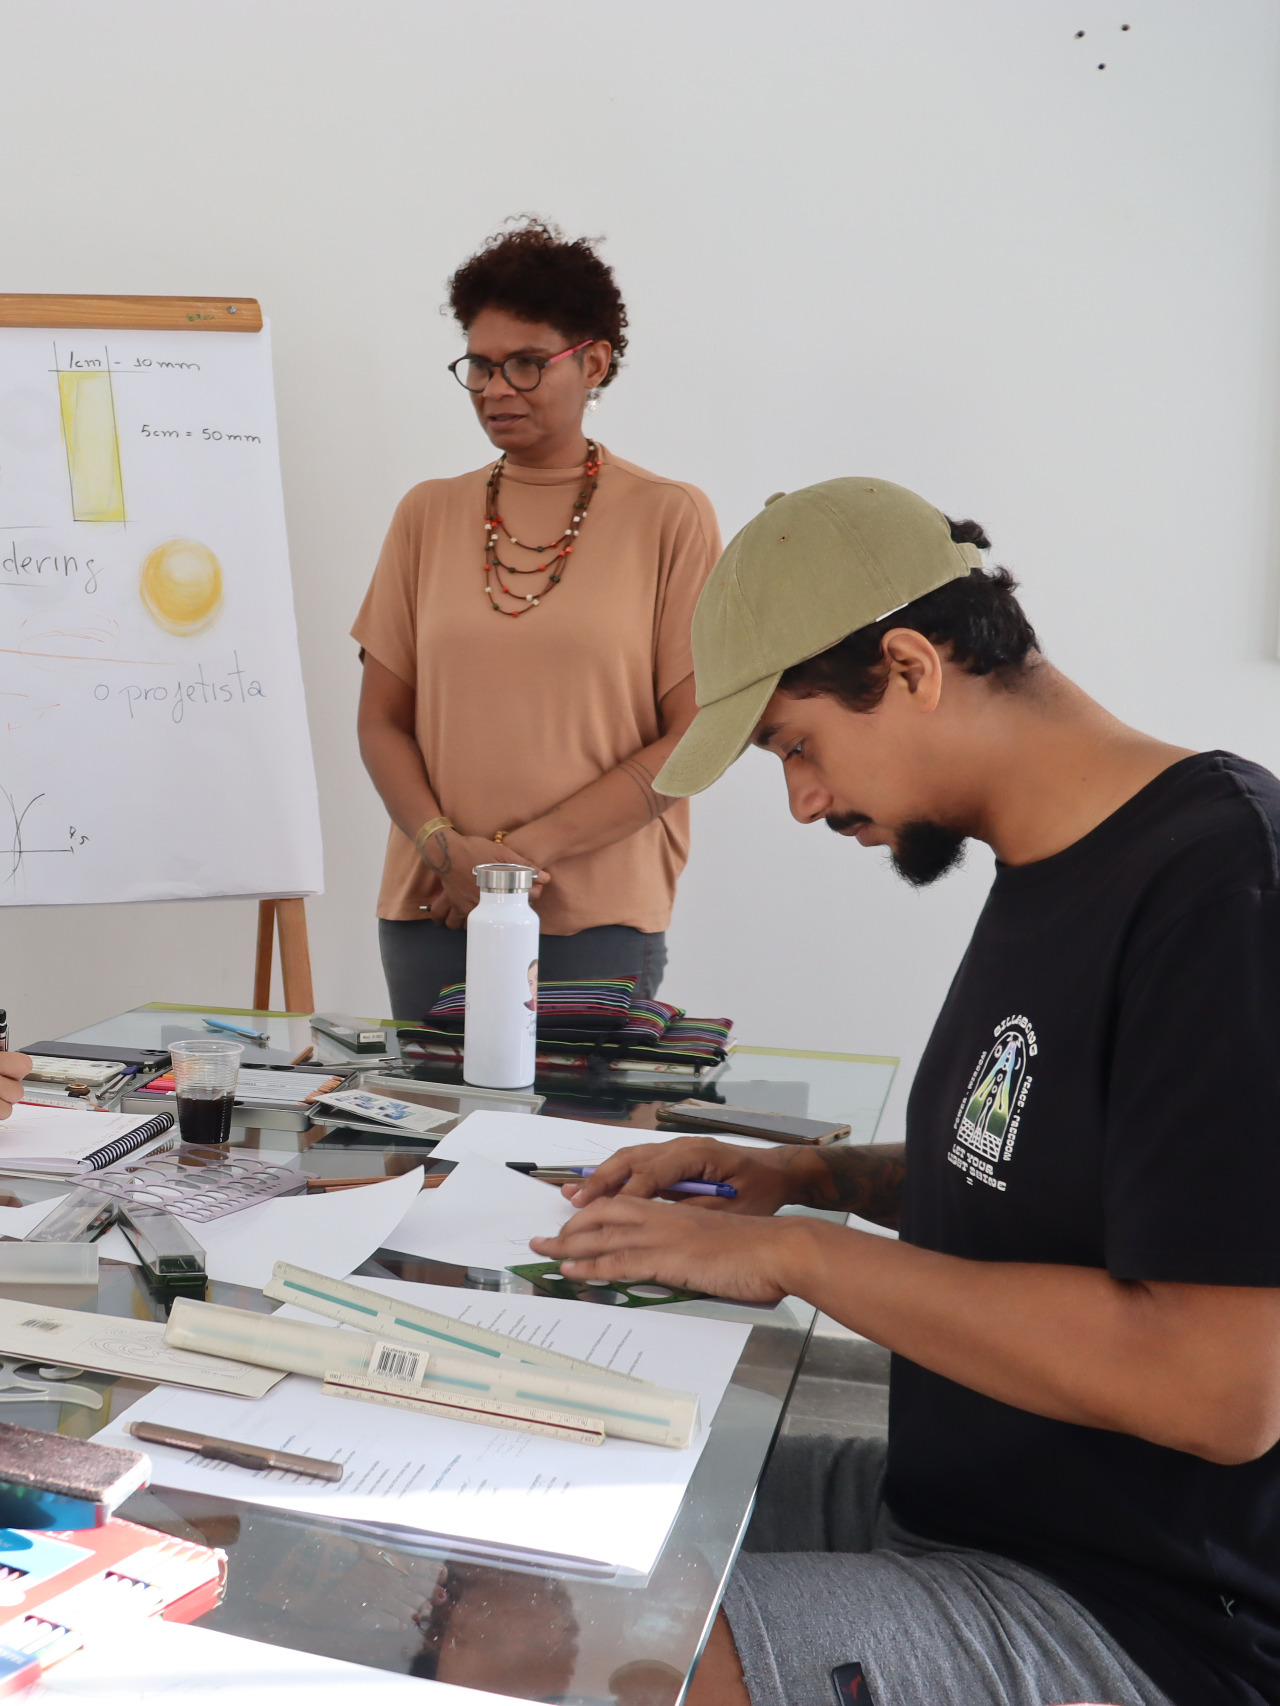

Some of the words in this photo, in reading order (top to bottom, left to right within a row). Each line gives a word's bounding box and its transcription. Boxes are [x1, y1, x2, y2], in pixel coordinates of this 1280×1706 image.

[69, 351, 102, 369] 1cm
[141, 425, 180, 440] 5cm
[202, 428, 261, 444] 50mm
[120, 650, 267, 723] projetista
[993, 1014, 1038, 1057] BILLABONG
[967, 1051, 987, 1090] WISDOM
[1017, 1075, 1033, 1108] PEACE
[1003, 1114, 1021, 1162] FREEDOM
[952, 1143, 967, 1159] LET
[966, 1152, 994, 1176] YOUR
[969, 1167, 1007, 1192] SHINE
